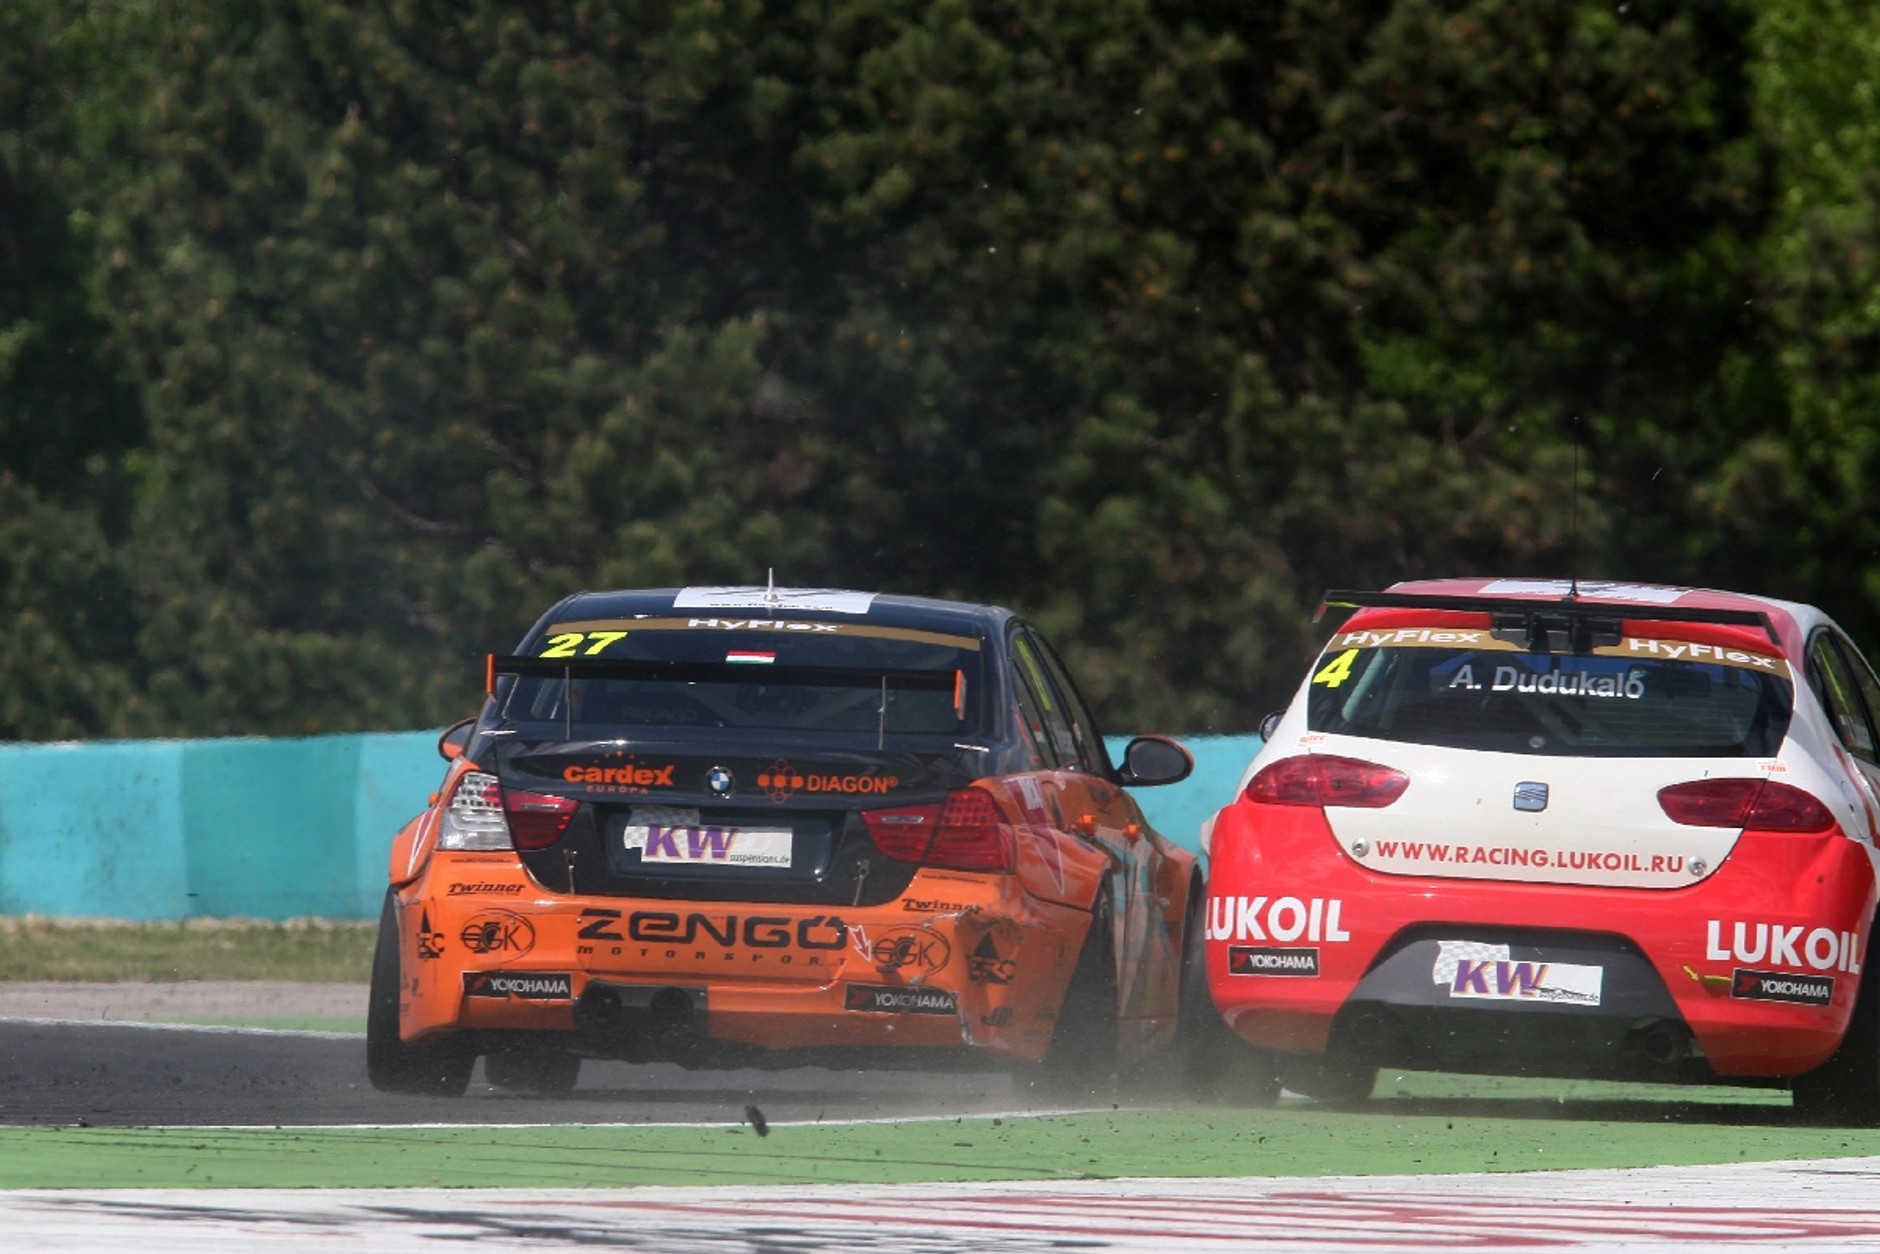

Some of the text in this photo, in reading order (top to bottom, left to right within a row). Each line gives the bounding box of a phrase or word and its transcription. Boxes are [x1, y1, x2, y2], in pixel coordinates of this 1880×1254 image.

[688, 619, 838, 632] HyFlex
[1341, 630, 1480, 647] HyFlex
[539, 632, 628, 659] 27
[1628, 637, 1776, 669] HyFlex
[1312, 648, 1359, 688] 4
[1450, 664, 1644, 699] A. Dudukalo
[563, 763, 675, 787] cardex
[586, 784, 649, 796] EUROPA
[644, 823, 739, 860] KW
[1376, 840, 1684, 873] WWW.RACING.LUKOIL.RU
[1205, 896, 1350, 942] LUKOIL
[1706, 920, 1860, 975] LUKOIL
[1249, 953, 1316, 970] YOKOHAMA
[490, 977, 569, 994] YOKOHAMA
[1453, 959, 1549, 997] KW
[1760, 979, 1830, 998] YOKOHAMA
[874, 993, 955, 1009] YOKOHAMA
